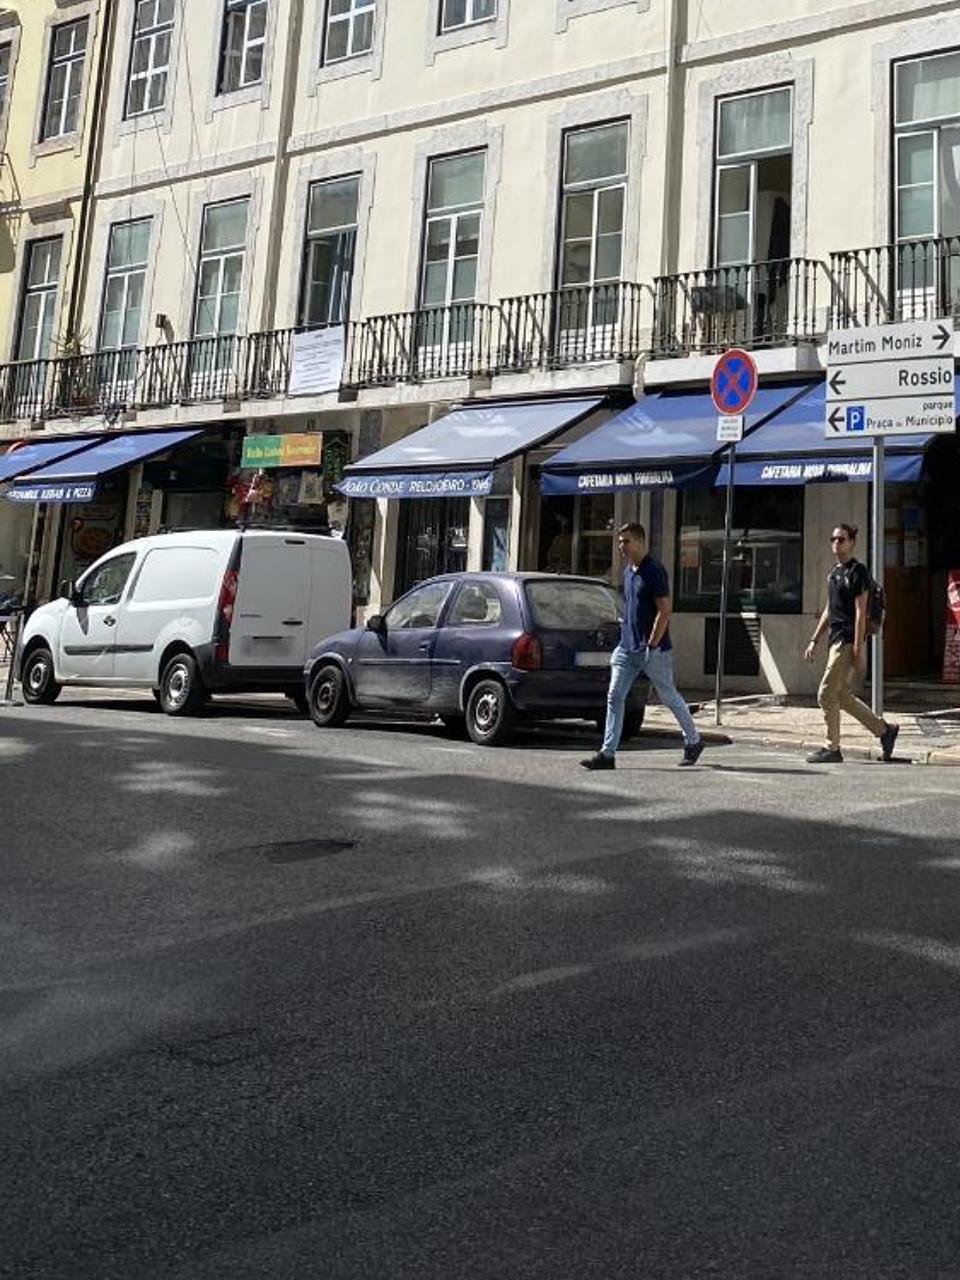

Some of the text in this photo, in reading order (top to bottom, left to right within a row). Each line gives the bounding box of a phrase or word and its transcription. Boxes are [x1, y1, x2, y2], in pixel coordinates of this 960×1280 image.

[829, 334, 922, 356] Martim Moniz
[898, 367, 952, 387] Rossio
[923, 402, 953, 412] parque
[867, 417, 893, 430] Praça
[615, 472, 634, 486] NOVA
